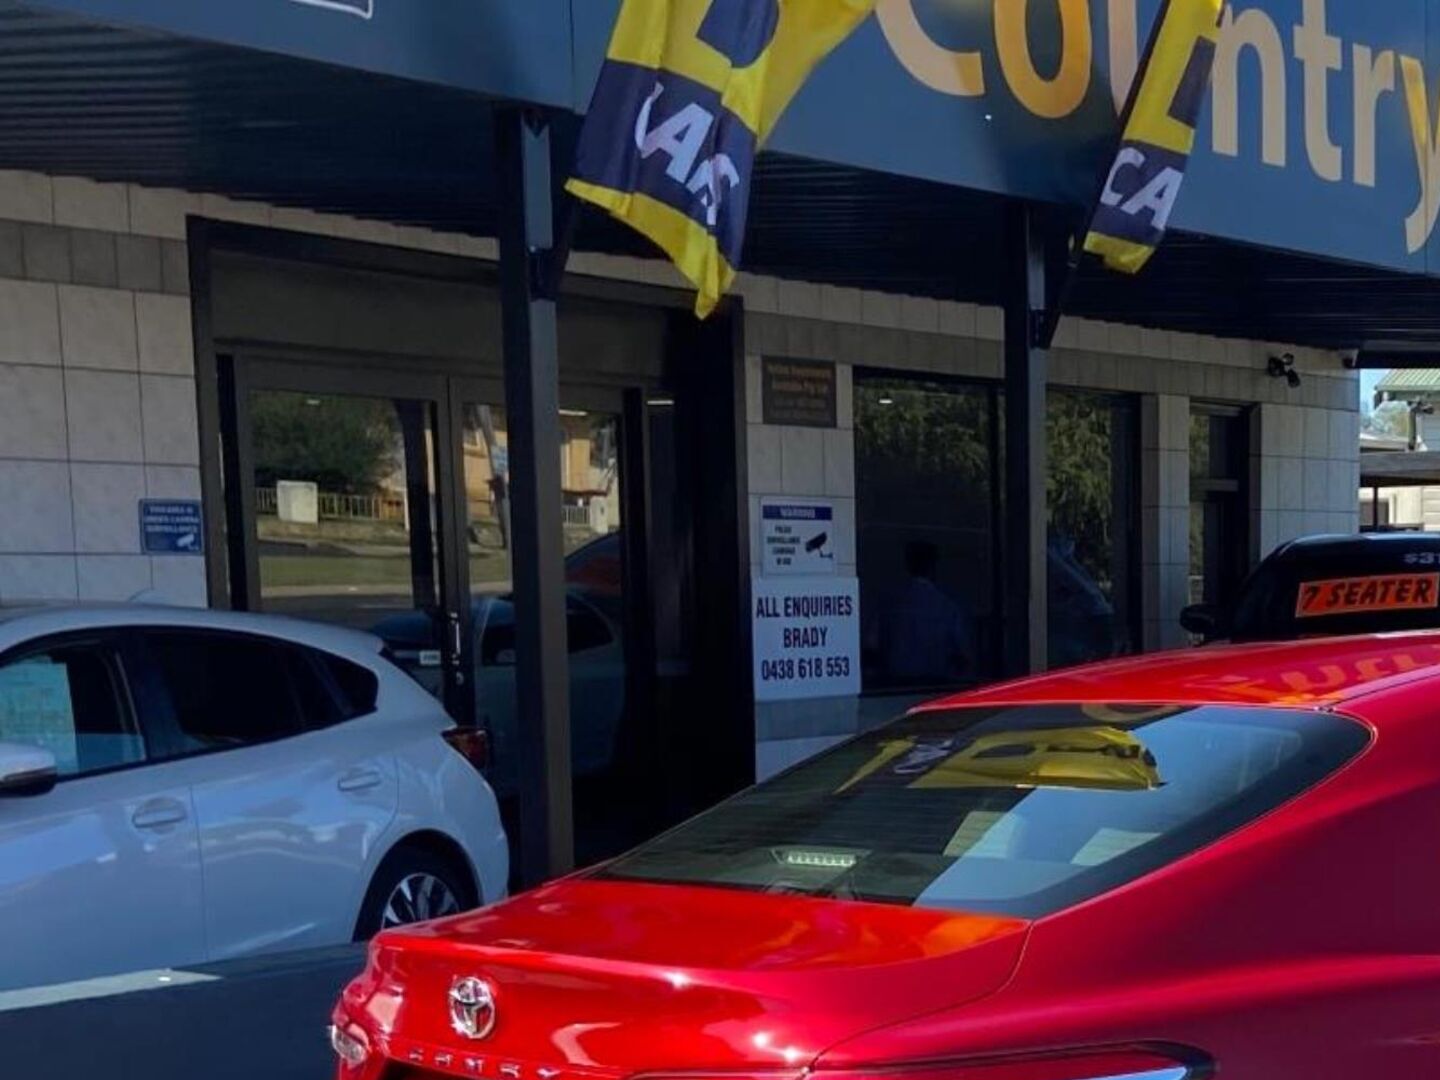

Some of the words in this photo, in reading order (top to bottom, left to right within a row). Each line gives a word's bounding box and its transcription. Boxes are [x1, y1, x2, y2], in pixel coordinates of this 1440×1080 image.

[1302, 584, 1319, 610] 7
[1326, 577, 1433, 607] SEATER
[756, 596, 780, 618] ALL
[783, 595, 853, 619] ENQUIRIES
[783, 626, 828, 648] BRADY
[761, 658, 795, 680] 0438
[797, 657, 823, 679] 618
[826, 656, 850, 678] 553
